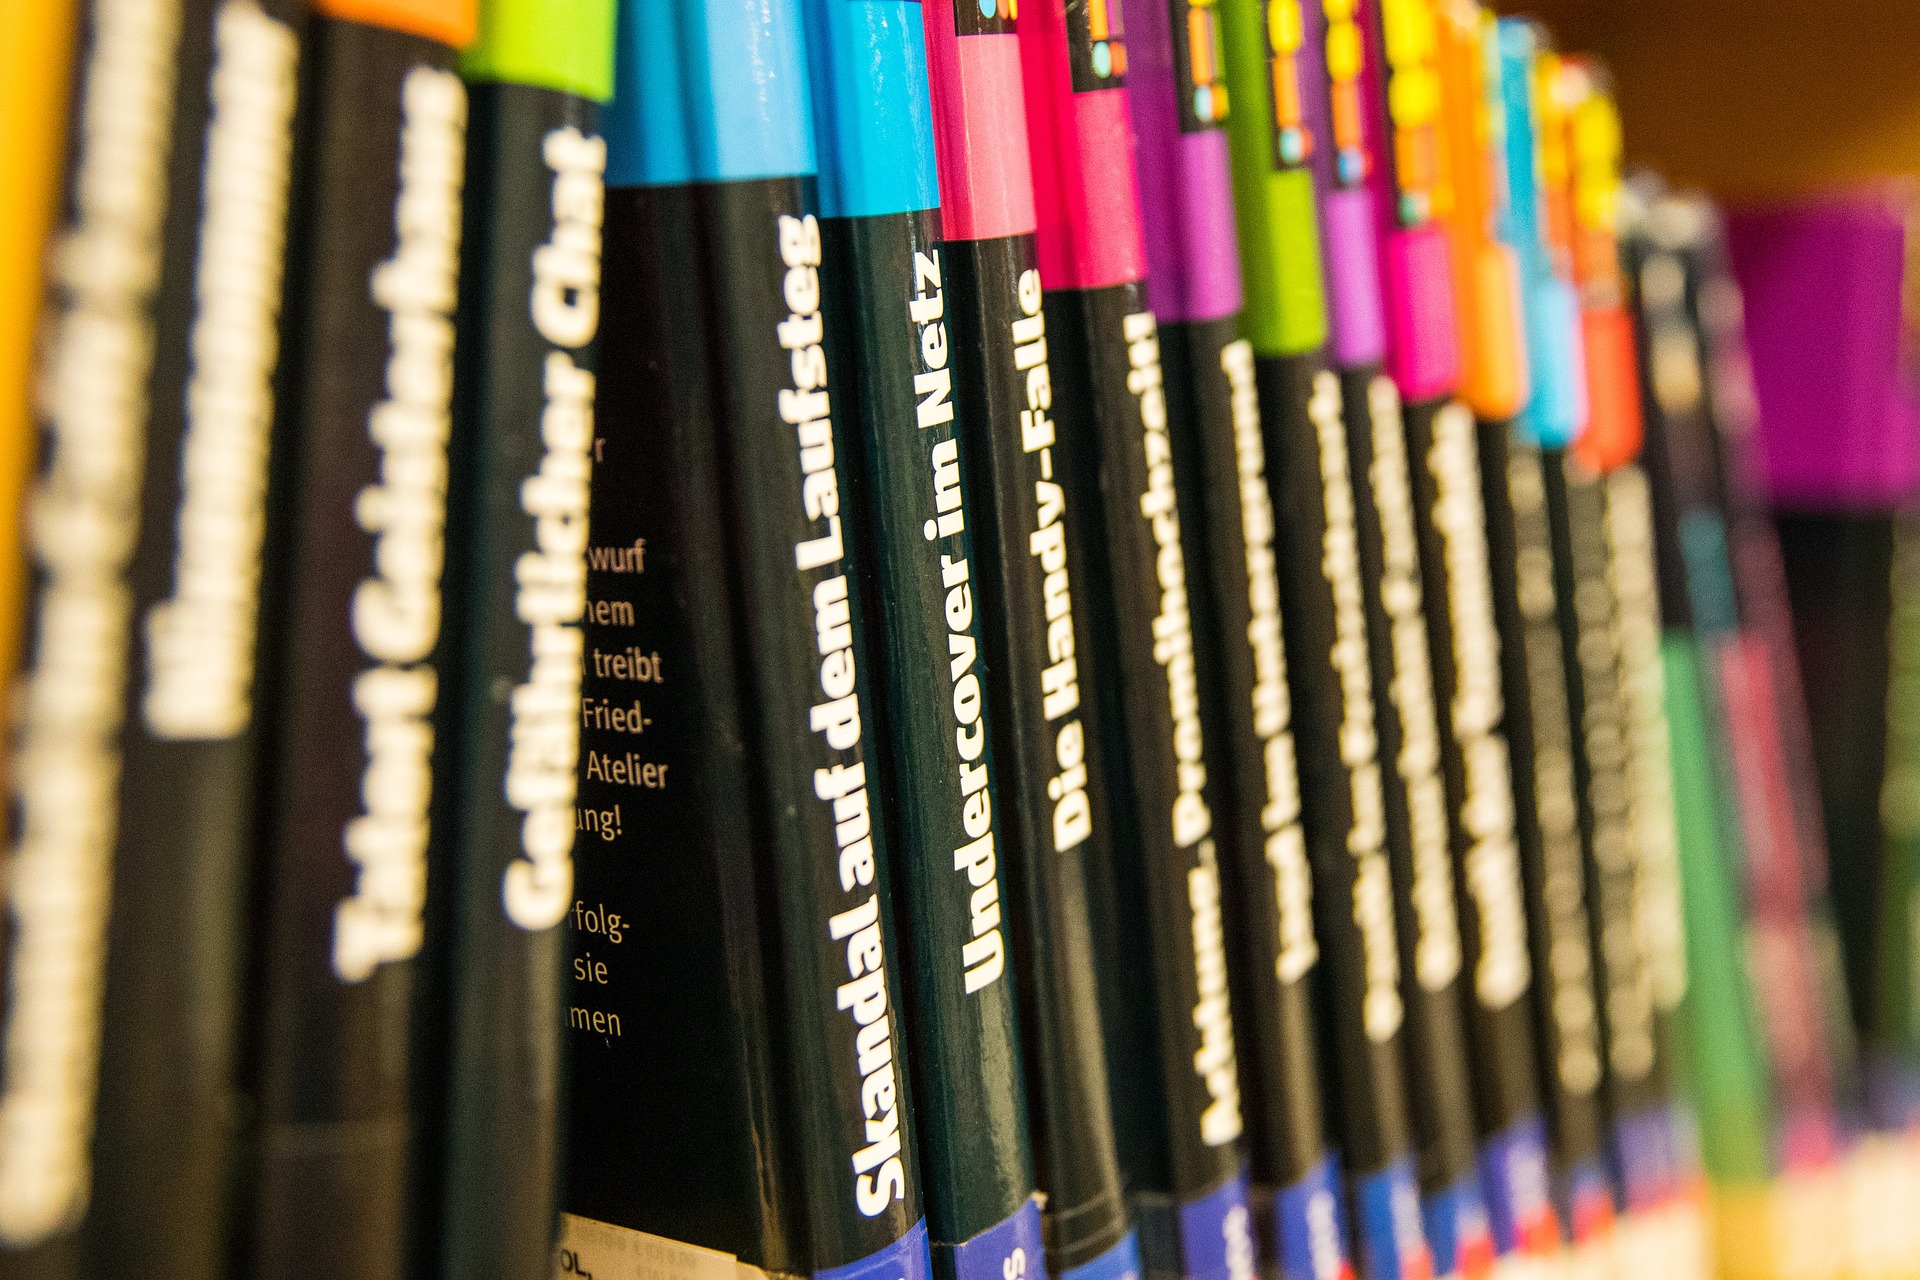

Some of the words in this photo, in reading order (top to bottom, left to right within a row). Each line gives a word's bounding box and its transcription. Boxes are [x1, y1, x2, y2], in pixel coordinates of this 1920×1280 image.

[777, 214, 844, 572] Laufsteg
[908, 248, 955, 430] Netz
[923, 437, 965, 541] im
[1010, 267, 1079, 721] Handy-Falle
[582, 697, 652, 734] Fried-
[593, 646, 664, 683] treibt
[808, 574, 862, 751] dem
[586, 750, 669, 789] Atelier
[812, 760, 876, 893] auf
[940, 553, 1004, 996] Undercover
[1046, 718, 1091, 853] Die
[566, 1005, 622, 1037] men
[573, 951, 608, 985] sie
[828, 894, 906, 1218] Skandal
